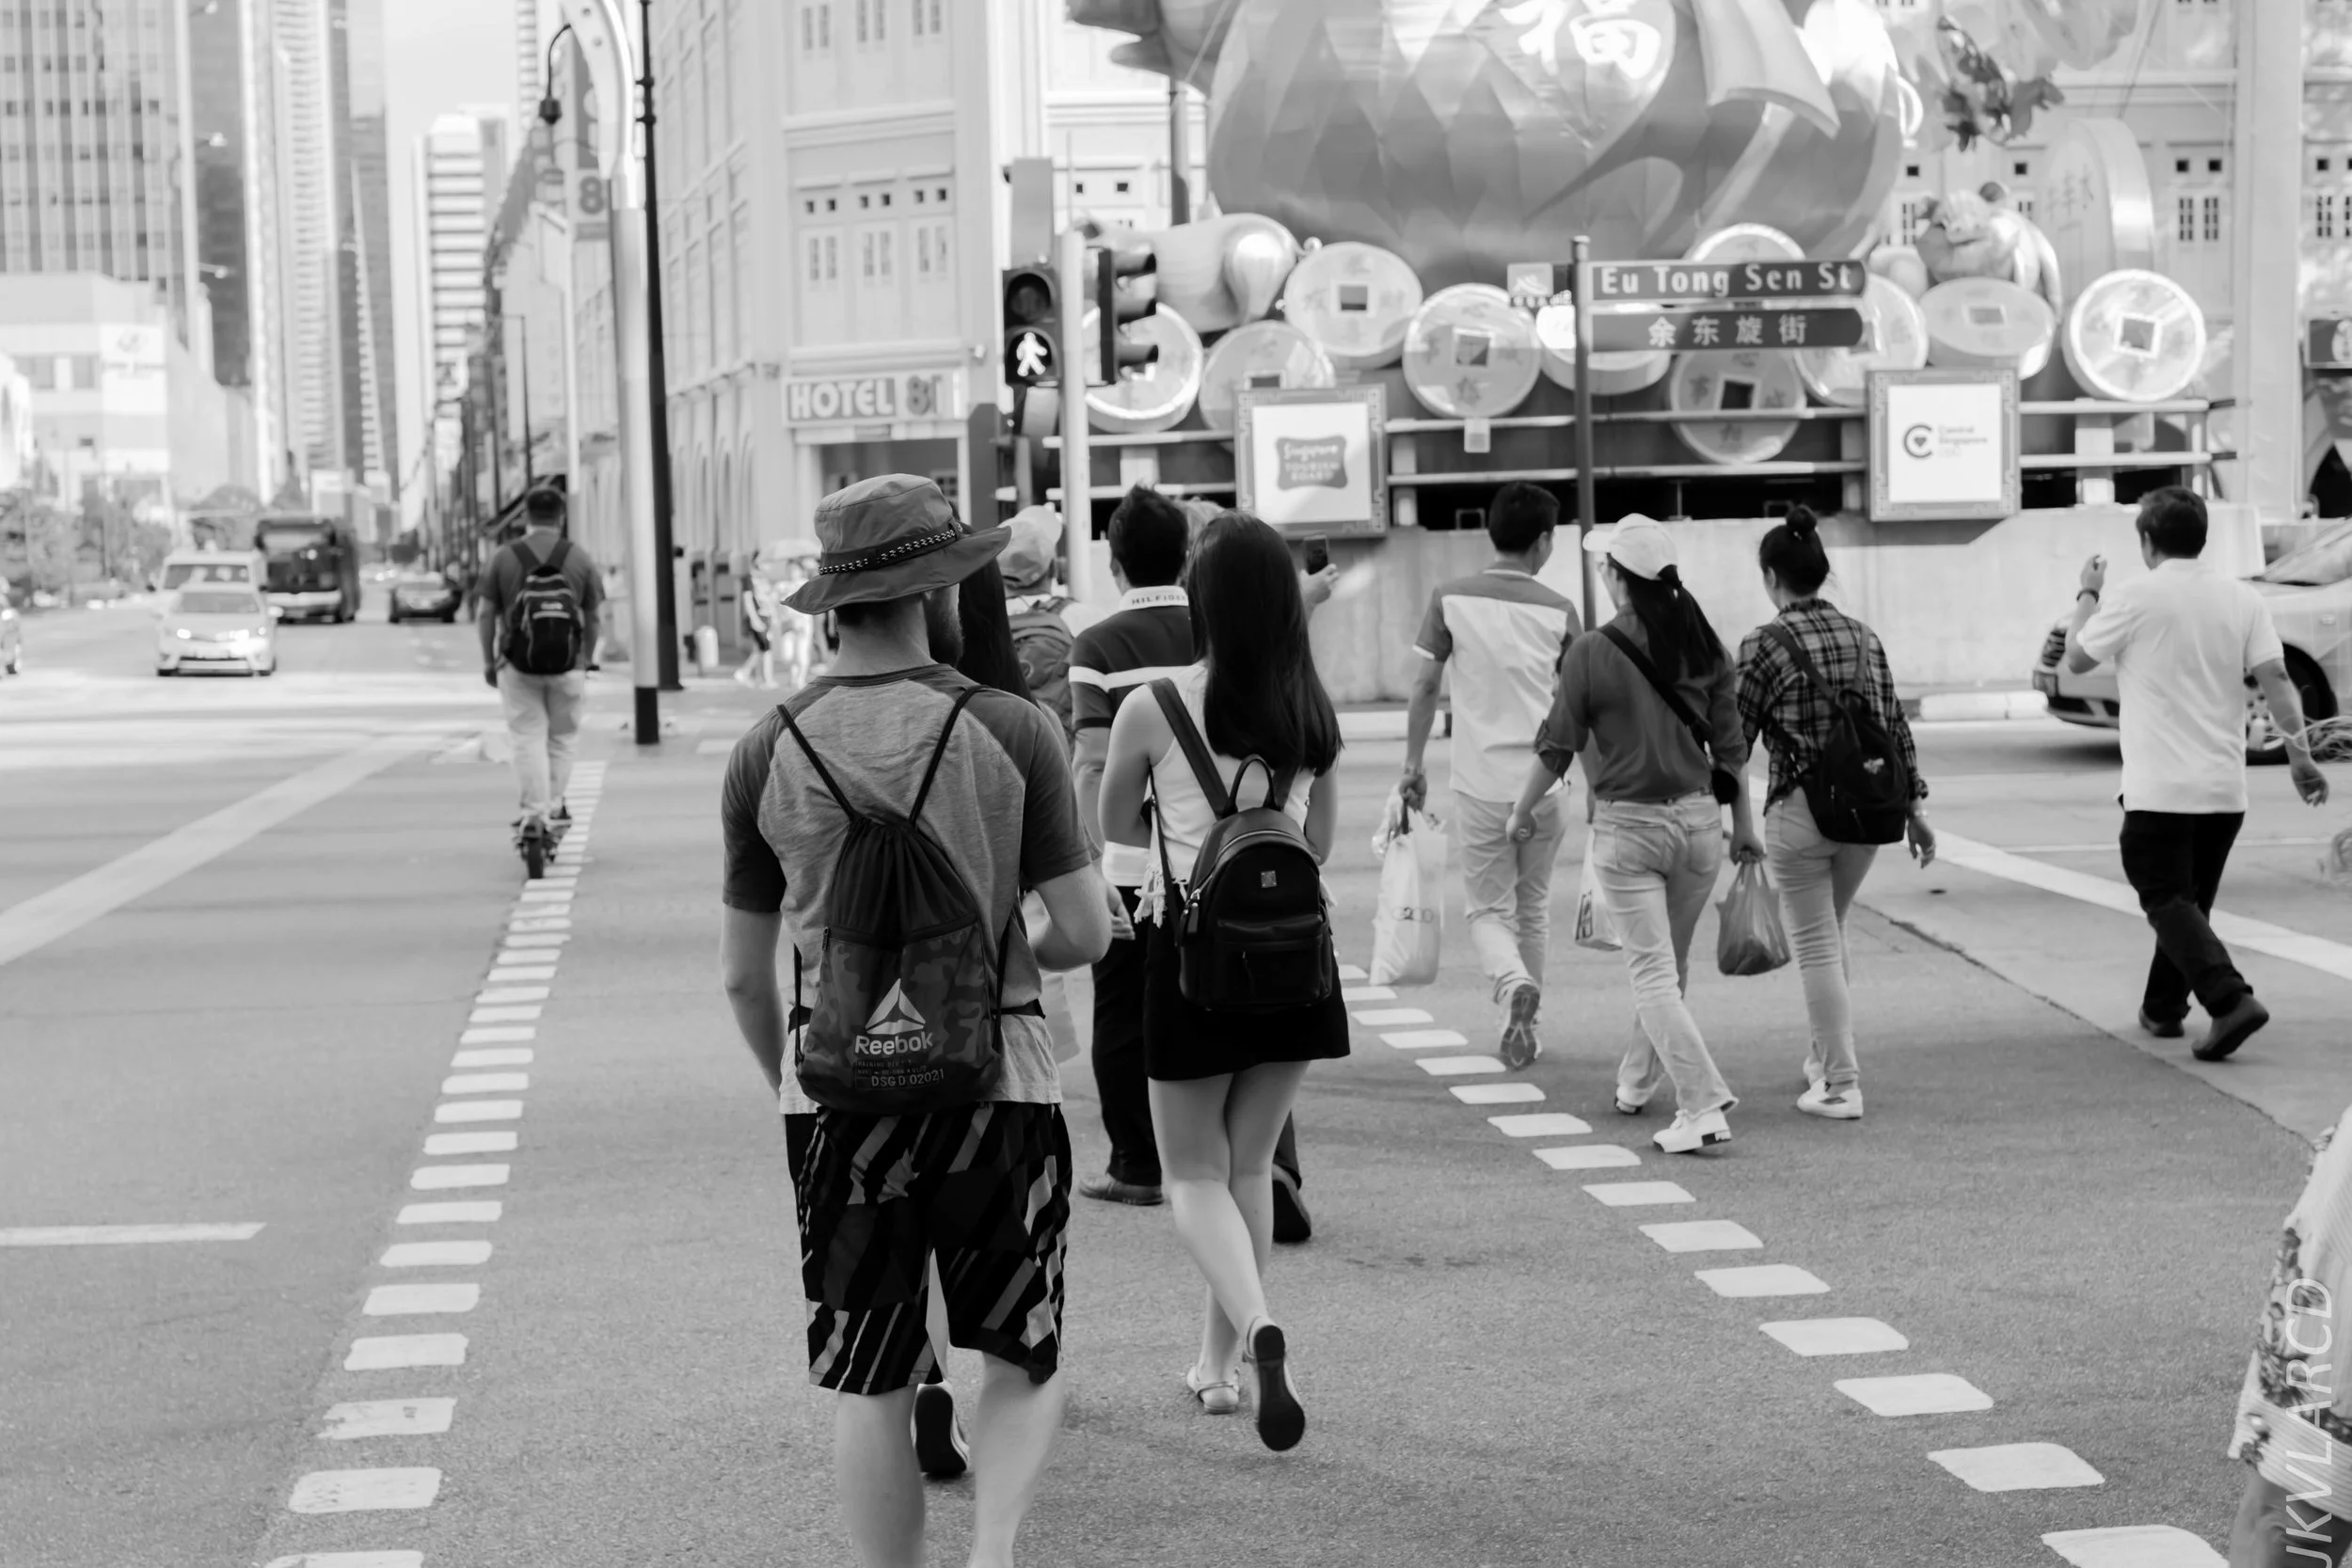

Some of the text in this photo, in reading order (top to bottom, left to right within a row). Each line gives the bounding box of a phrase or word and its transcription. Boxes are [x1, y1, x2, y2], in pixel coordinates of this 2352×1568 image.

[1601, 261, 1852, 297] Eu Tong Sen St
[1648, 315, 1807, 347] 余东旋街
[790, 379, 894, 420] HOTEL
[854, 1031, 933, 1055] Reebok
